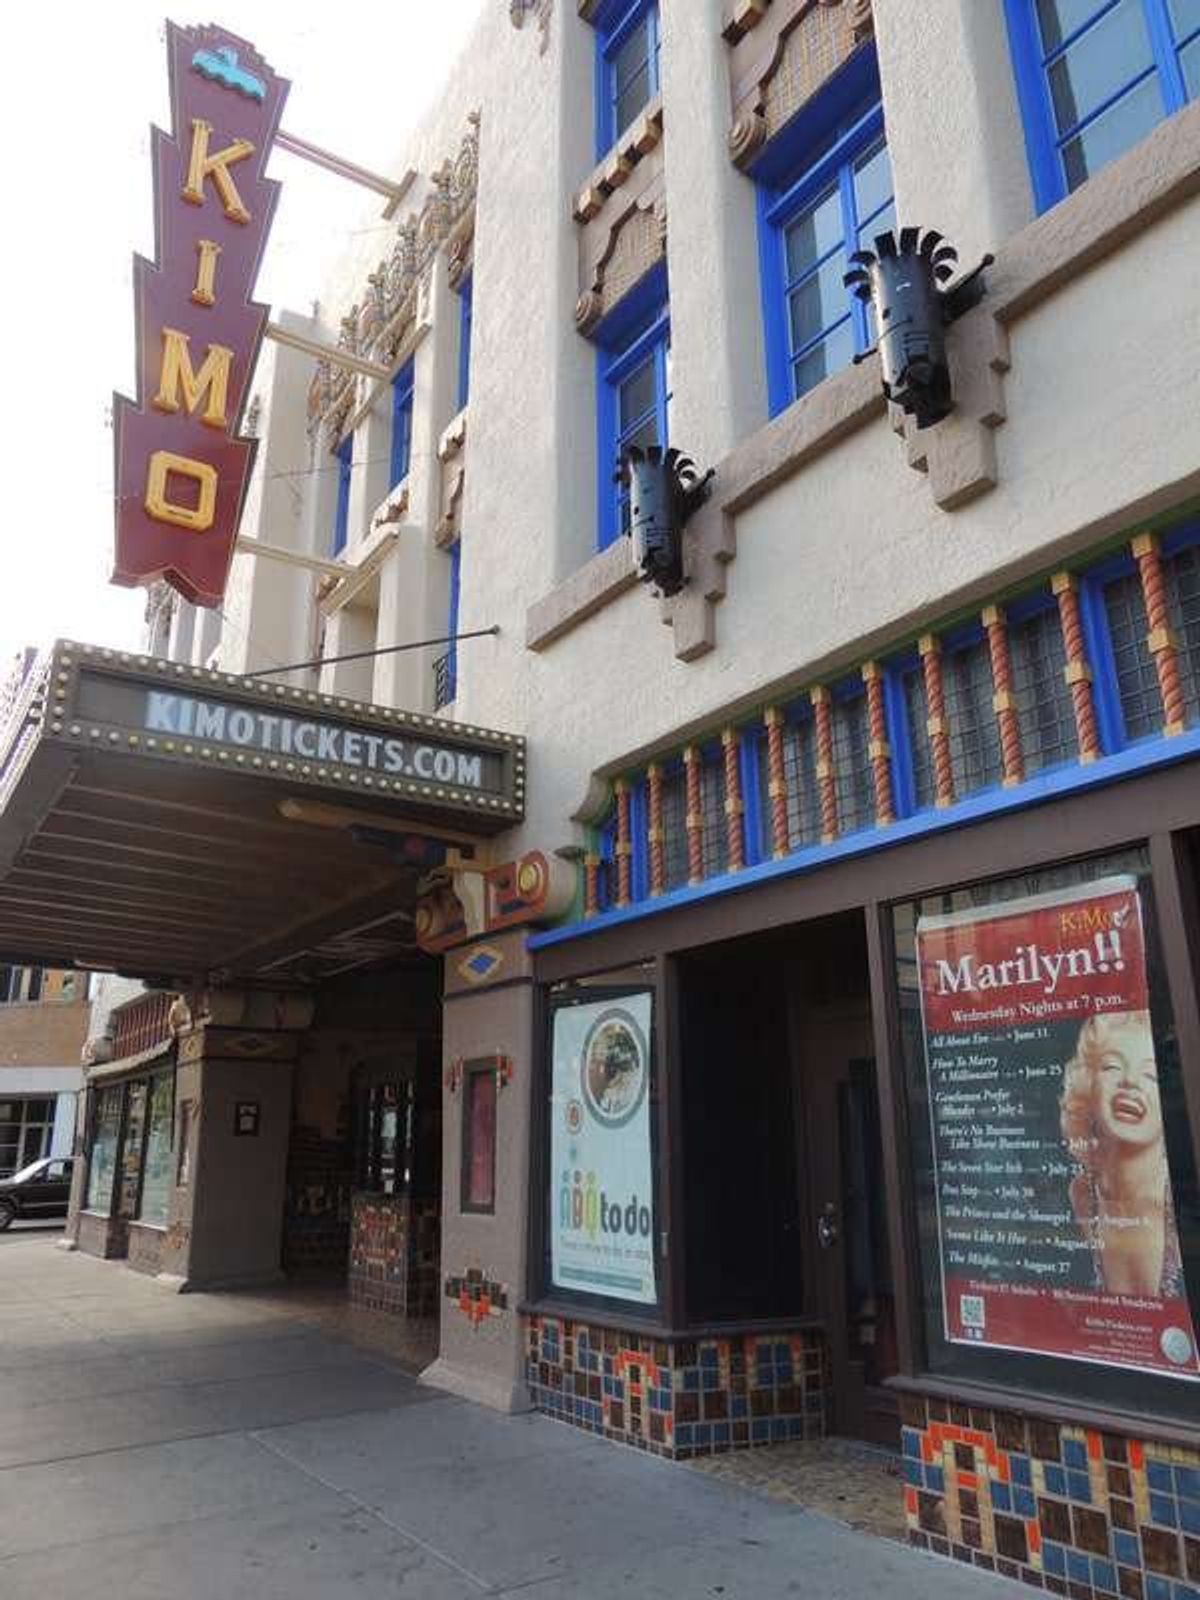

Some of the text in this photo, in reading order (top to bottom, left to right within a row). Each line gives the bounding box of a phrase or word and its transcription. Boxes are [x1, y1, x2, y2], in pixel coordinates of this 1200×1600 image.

[144, 117, 255, 531] KIMO
[144, 689, 483, 787] KIMOTICKETS.COM
[936, 929, 1126, 995] Marilyn!!
[952, 1005, 1016, 1024] Wednesday
[1020, 1001, 1064, 1018] Nights
[1066, 999, 1079, 1011] at
[1081, 996, 1090, 1007] 7
[1036, 1027, 1048, 1038] 11
[969, 1055, 998, 1069] Marry
